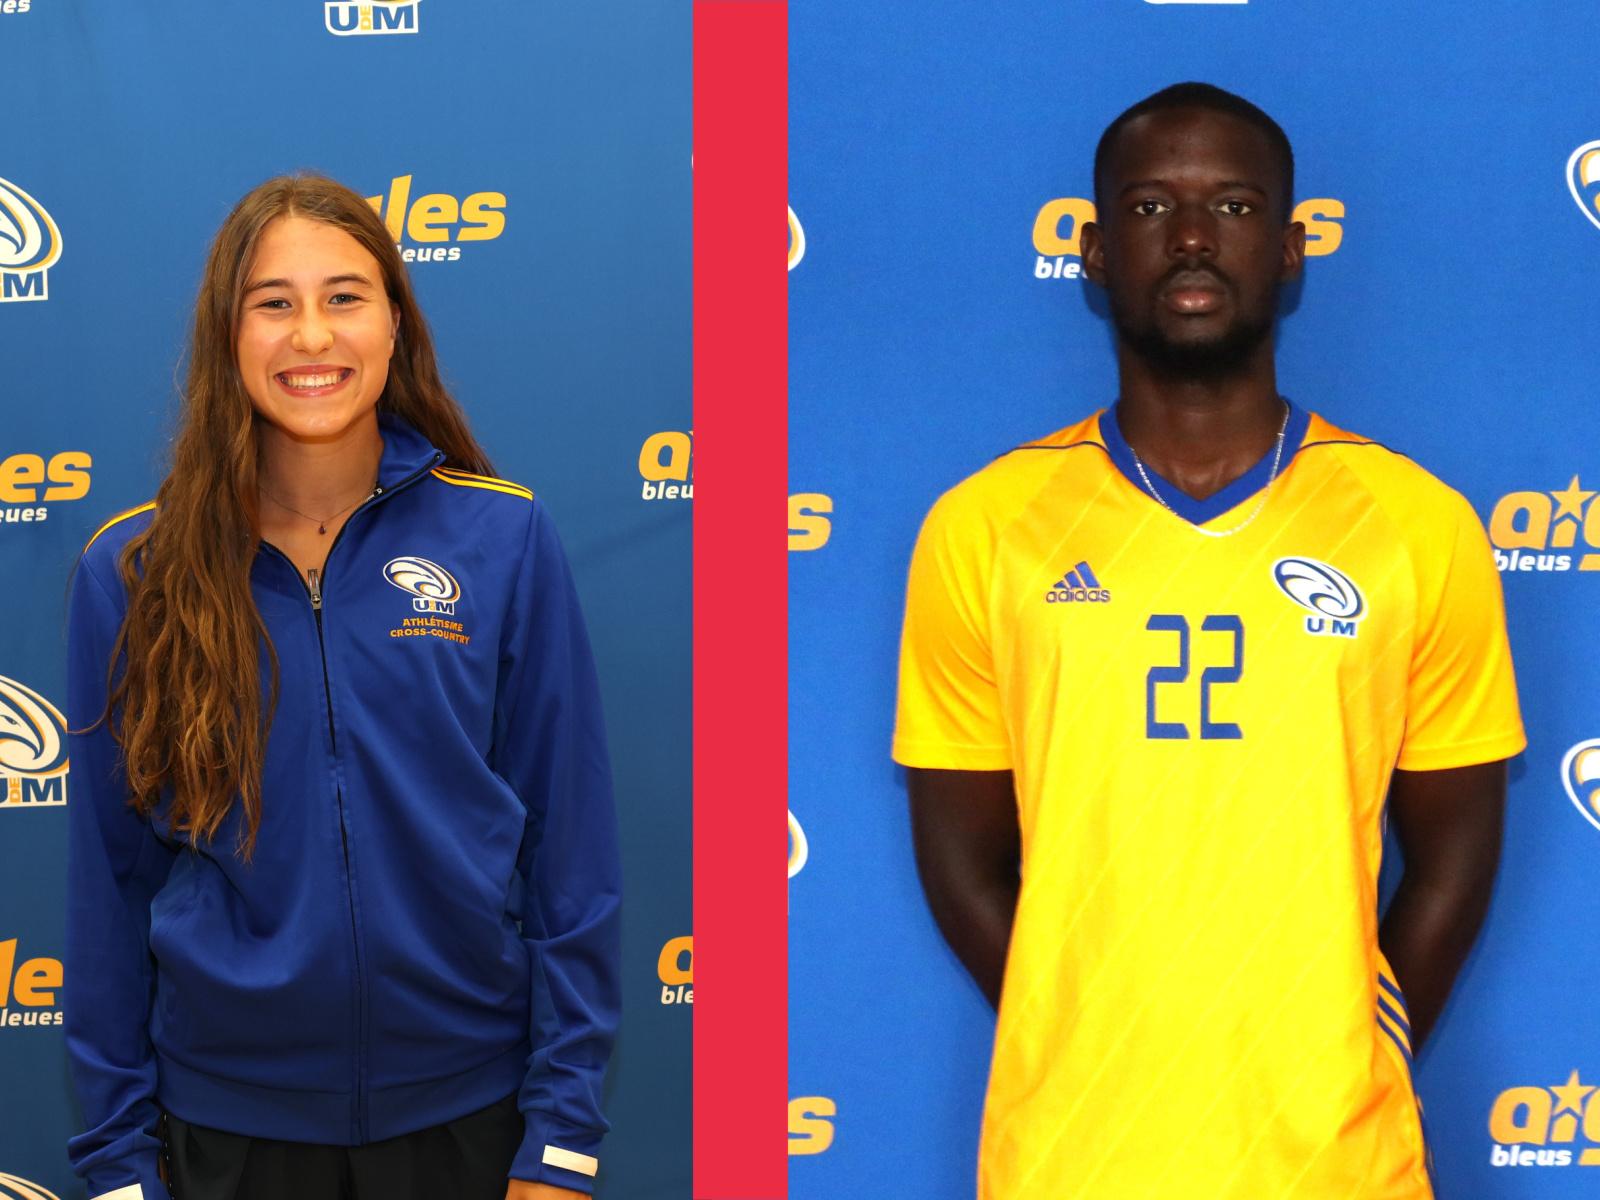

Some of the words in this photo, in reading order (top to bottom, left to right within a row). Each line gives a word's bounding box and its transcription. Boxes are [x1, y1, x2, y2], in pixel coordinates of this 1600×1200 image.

[0, 0, 31, 14] es
[365, 174, 507, 243] les
[397, 246, 461, 263] eues
[1034, 256, 1087, 279] ble
[0, 507, 48, 523] ues
[1493, 549, 1572, 572] bleus
[1046, 588, 1111, 604] adidas
[402, 615, 464, 632] ATHLÉTISME
[390, 628, 470, 645] CROSS-COUNTRY
[1146, 614, 1245, 740] 22
[1490, 1144, 1572, 1167] bleus
